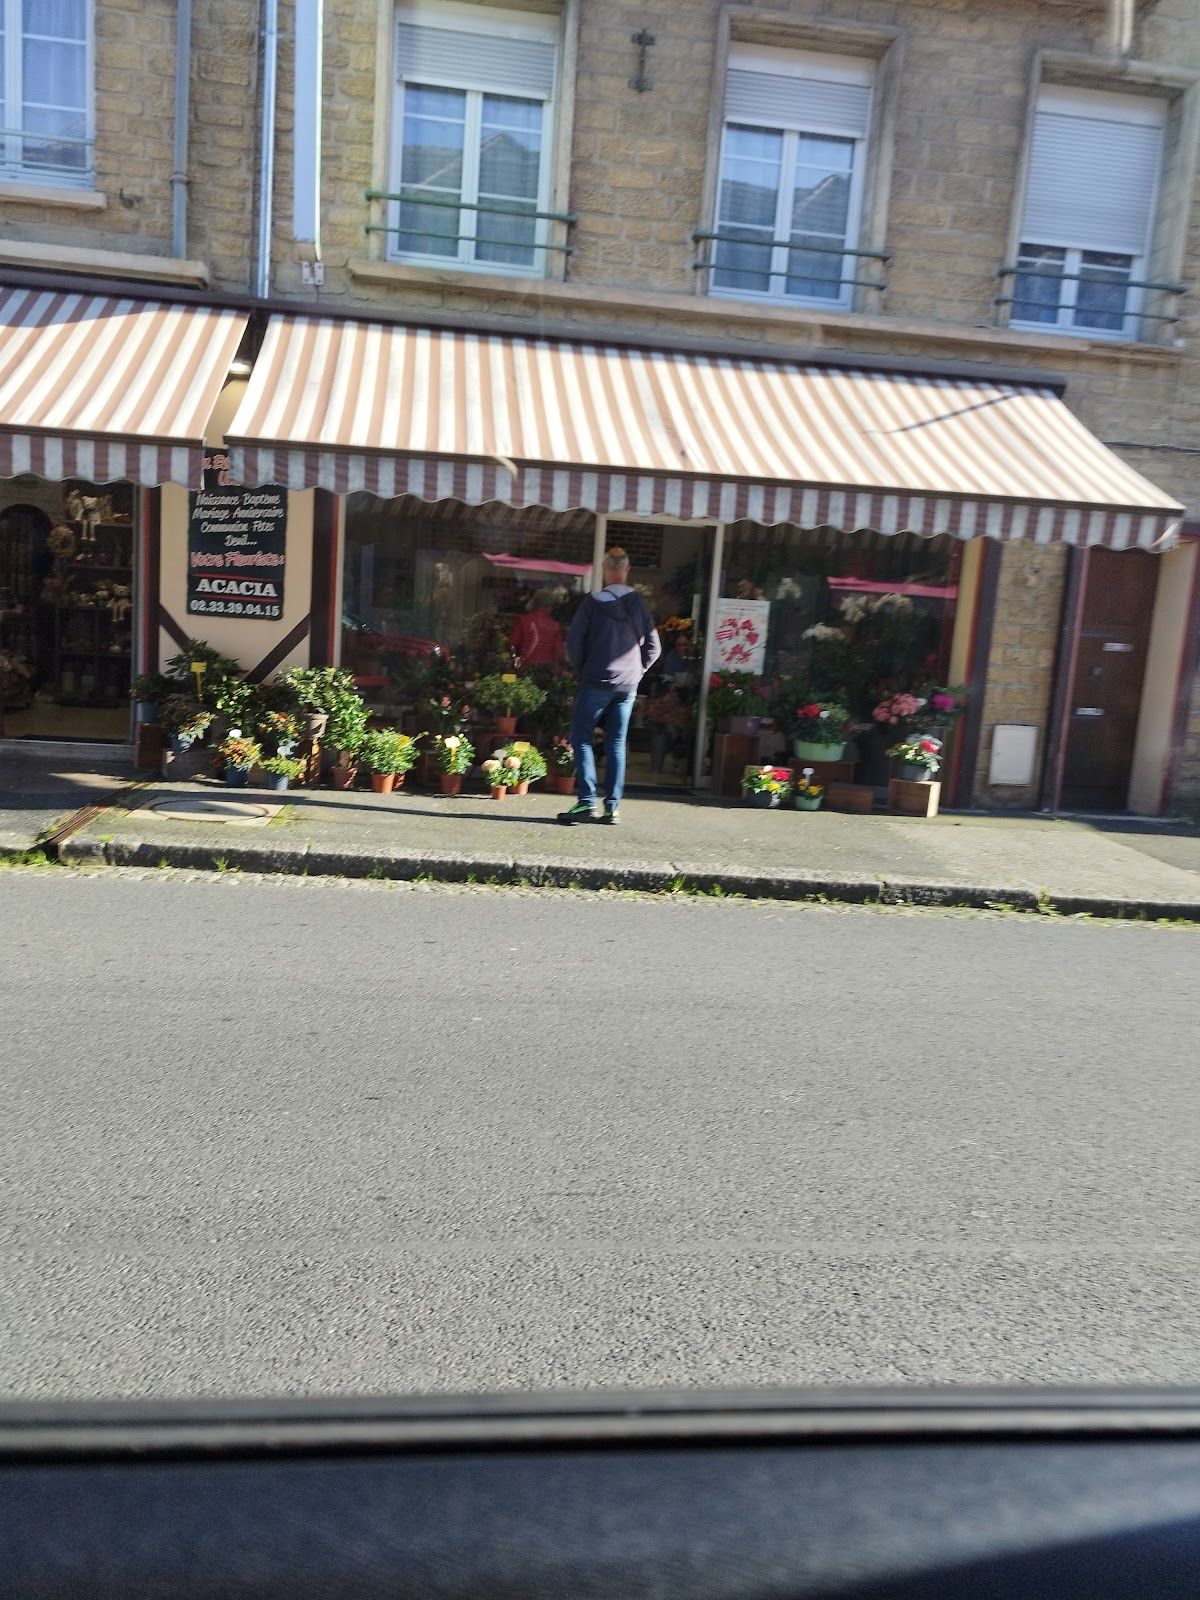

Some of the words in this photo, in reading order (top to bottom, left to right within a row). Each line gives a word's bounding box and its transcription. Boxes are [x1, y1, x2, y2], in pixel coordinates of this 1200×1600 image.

[196, 493, 240, 506] Naissance
[192, 507, 230, 521] Mariage
[231, 506, 284, 519] Anniversaire
[200, 520, 249, 533] Communion
[190, 551, 224, 567] Votre
[195, 578, 277, 597] ACACIA
